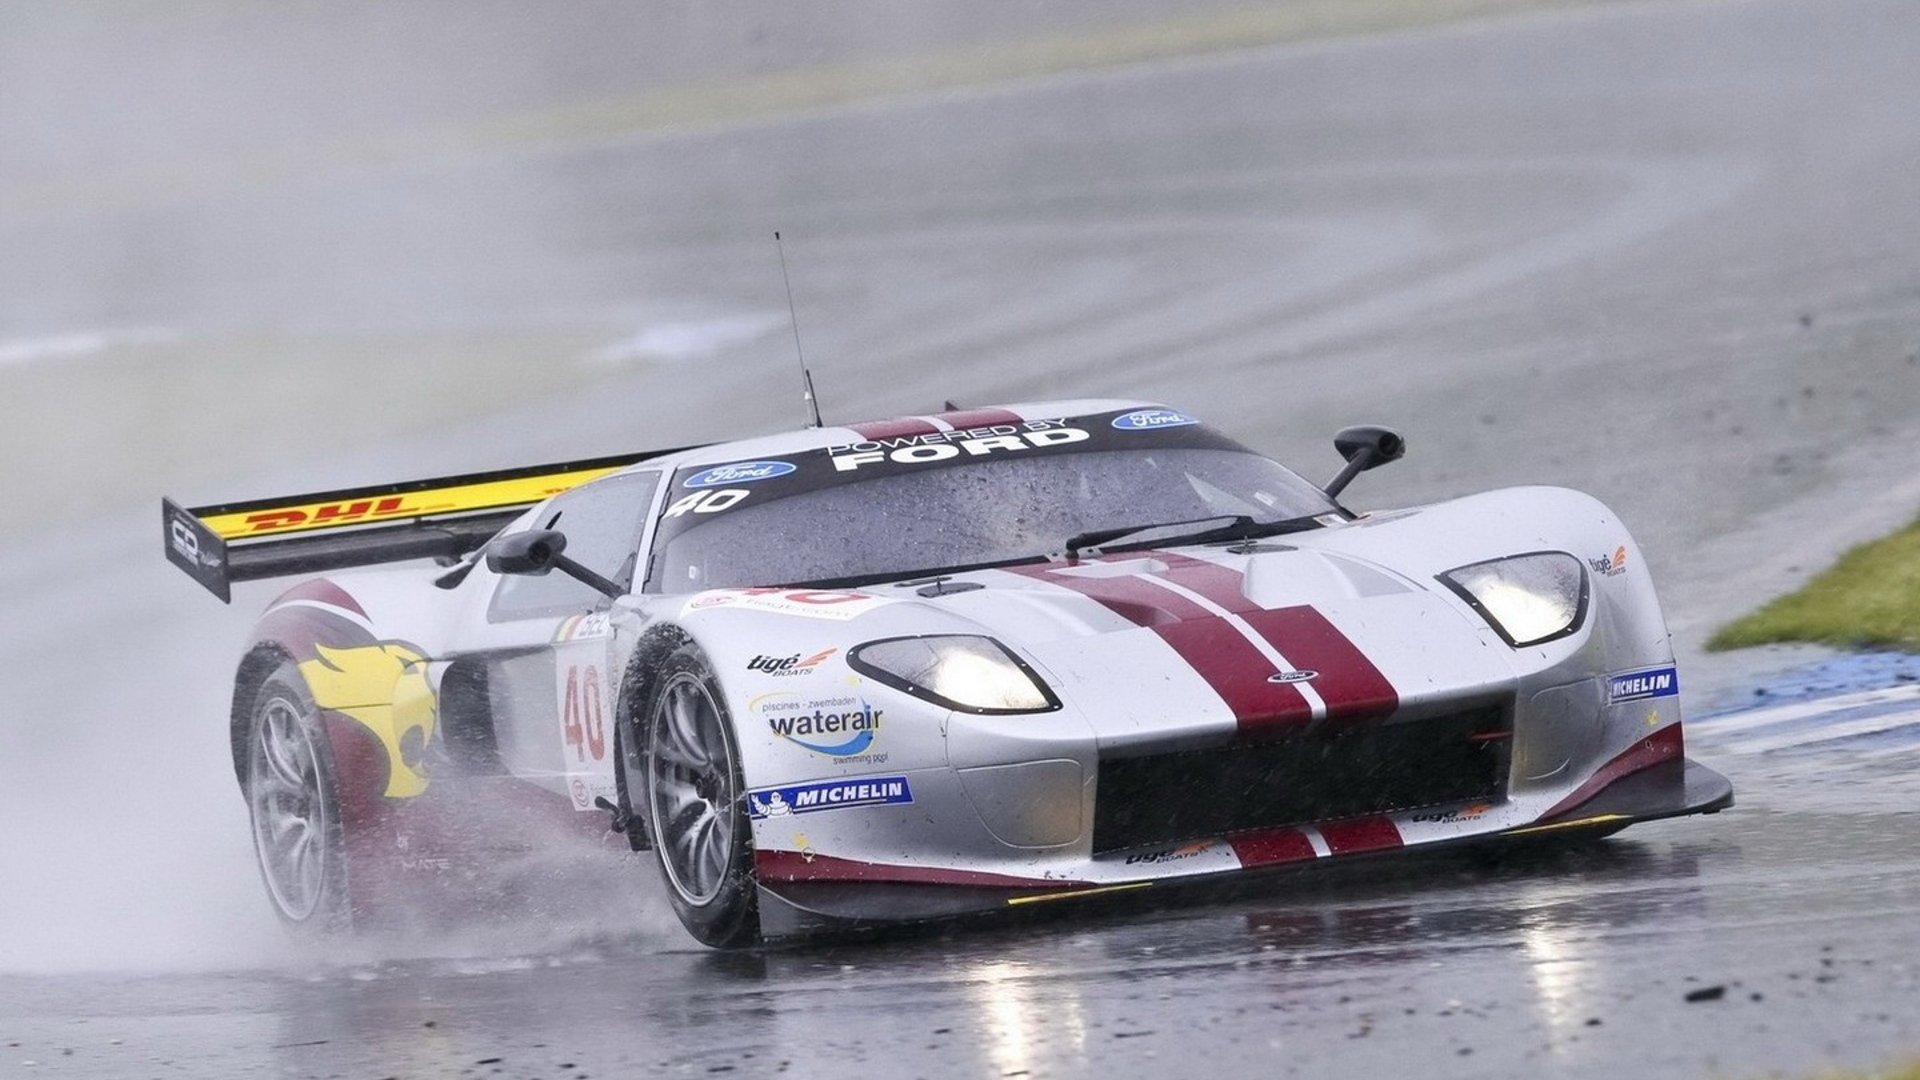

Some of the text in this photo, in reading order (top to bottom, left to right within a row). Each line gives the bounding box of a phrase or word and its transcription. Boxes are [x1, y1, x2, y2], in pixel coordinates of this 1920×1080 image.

[1129, 411, 1184, 427] Ford
[826, 417, 1068, 456] POWERED BY
[831, 428, 1090, 471] FORD
[704, 463, 774, 483] Ford
[245, 497, 419, 531] DHL
[662, 489, 750, 519] 40
[747, 652, 801, 674] tigé
[772, 667, 814, 677] BOATS
[564, 665, 605, 762] 40
[762, 701, 801, 713] piscines
[807, 697, 857, 709] zwembaden
[769, 705, 883, 736] waterair
[833, 752, 889, 765] swimming pool
[796, 782, 902, 807] MICHELIN
